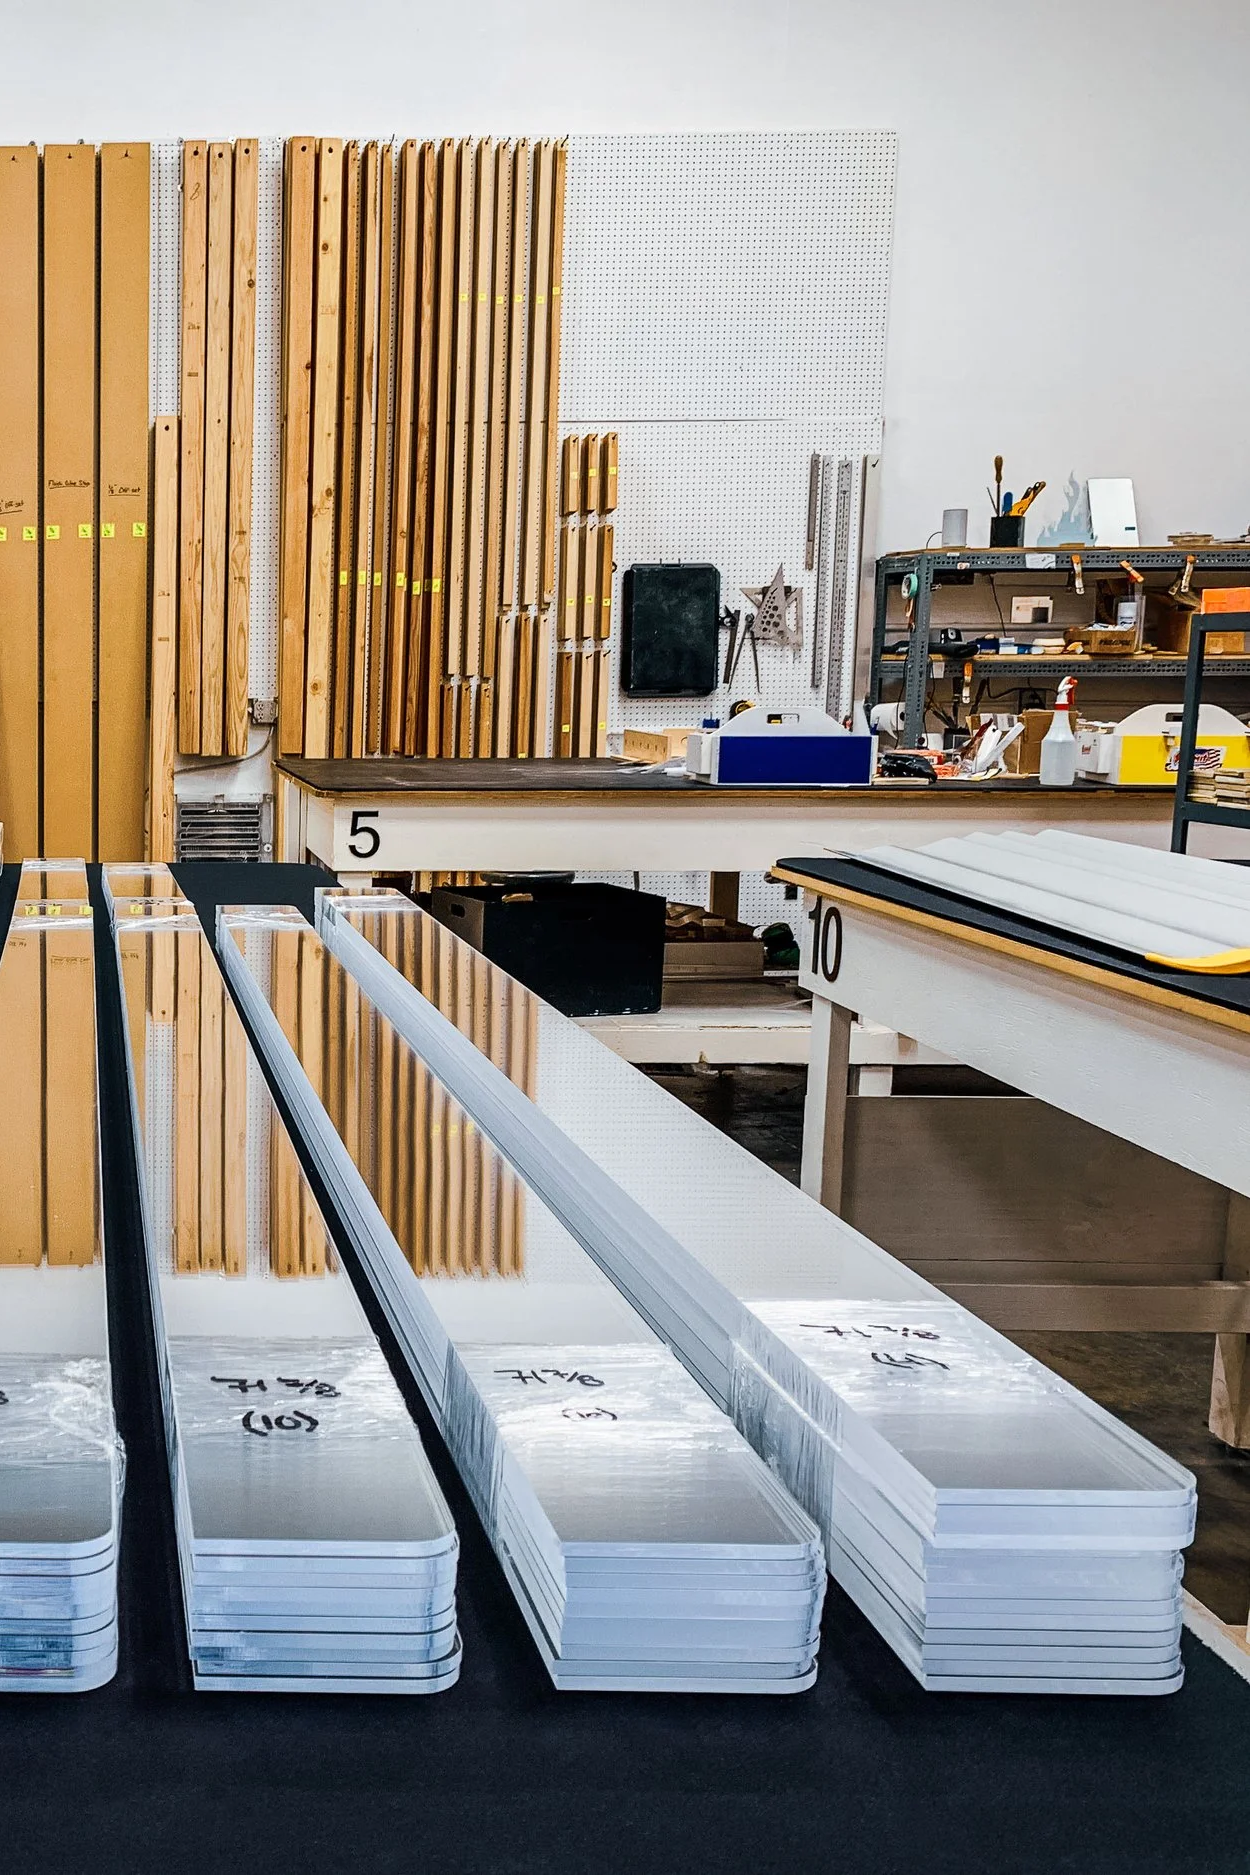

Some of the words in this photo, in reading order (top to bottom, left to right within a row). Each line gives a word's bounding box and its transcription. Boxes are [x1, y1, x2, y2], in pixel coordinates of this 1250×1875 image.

[348, 811, 380, 858] 5
[808, 894, 842, 983] 10
[241, 1410, 319, 1437] (10)
